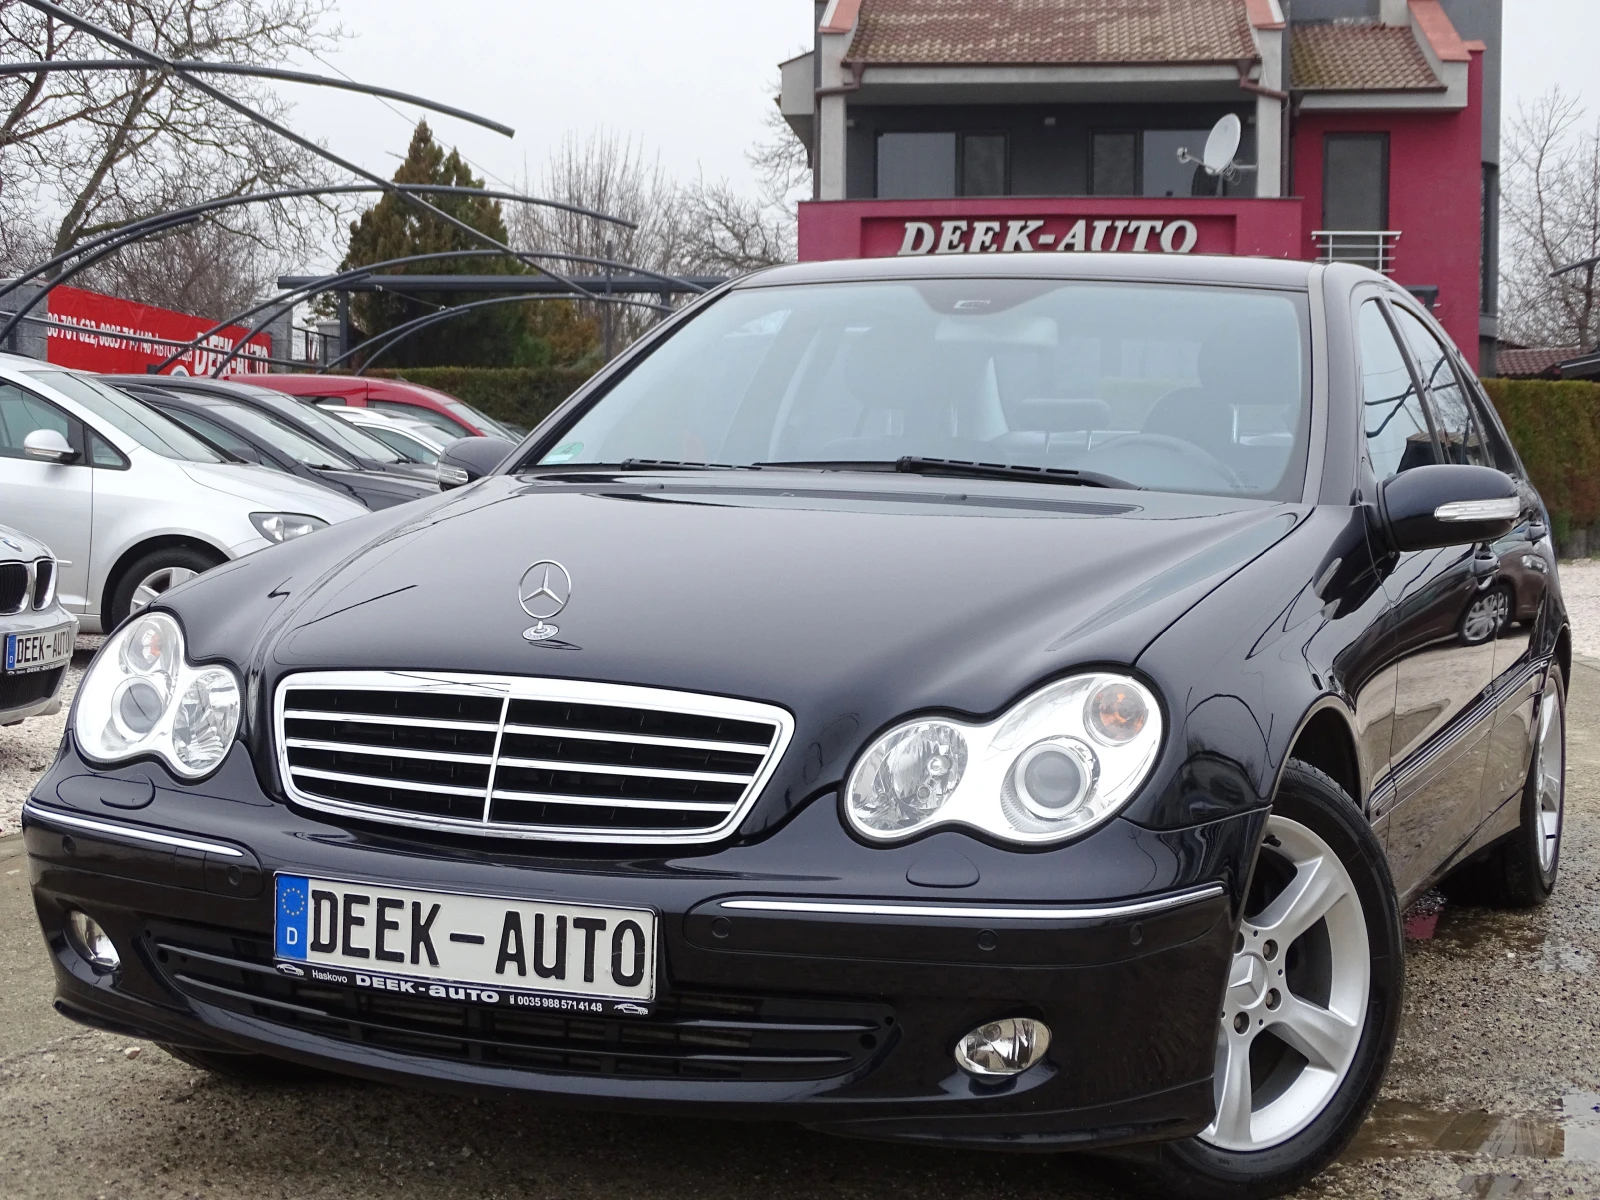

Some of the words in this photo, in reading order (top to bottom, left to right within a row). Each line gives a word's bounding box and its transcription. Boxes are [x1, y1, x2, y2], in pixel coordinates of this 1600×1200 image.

[897, 219, 1198, 256] DEEK-AUTO
[16, 630, 70, 663] DEEK-AUTO
[286, 927, 298, 946] D
[310, 890, 646, 987] DEEK-AUTO
[312, 969, 348, 984] Haskovo
[517, 996, 541, 1007] 0035
[542, 998, 560, 1008] 988
